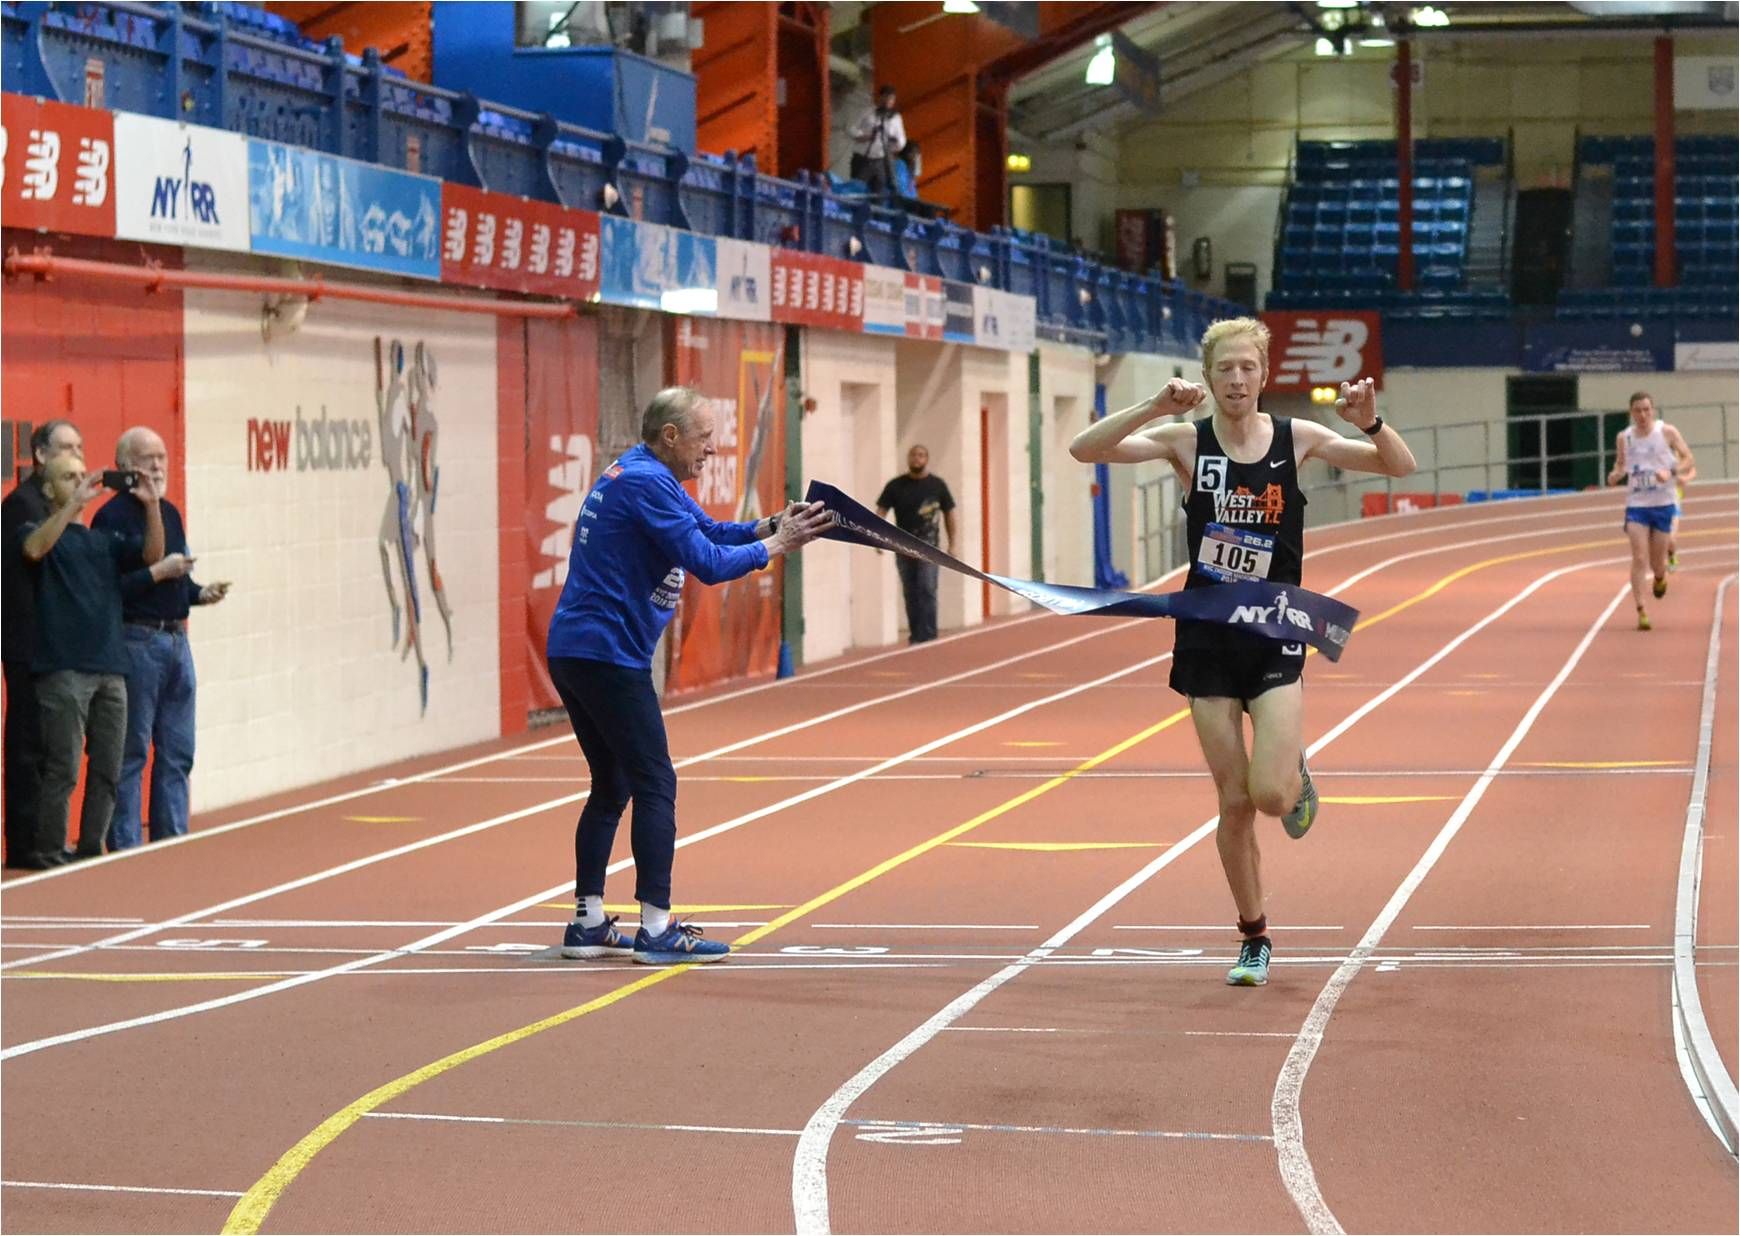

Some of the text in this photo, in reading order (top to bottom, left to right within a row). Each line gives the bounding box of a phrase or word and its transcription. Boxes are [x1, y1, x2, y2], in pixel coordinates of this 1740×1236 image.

[1275, 320, 1368, 383] NB
[248, 405, 372, 473] new balance
[1201, 458, 1221, 491] 5
[1213, 490, 1256, 508] WEST
[1215, 508, 1265, 524] VALLEY
[1243, 535, 1273, 548] 26.2
[1212, 543, 1259, 573] 105
